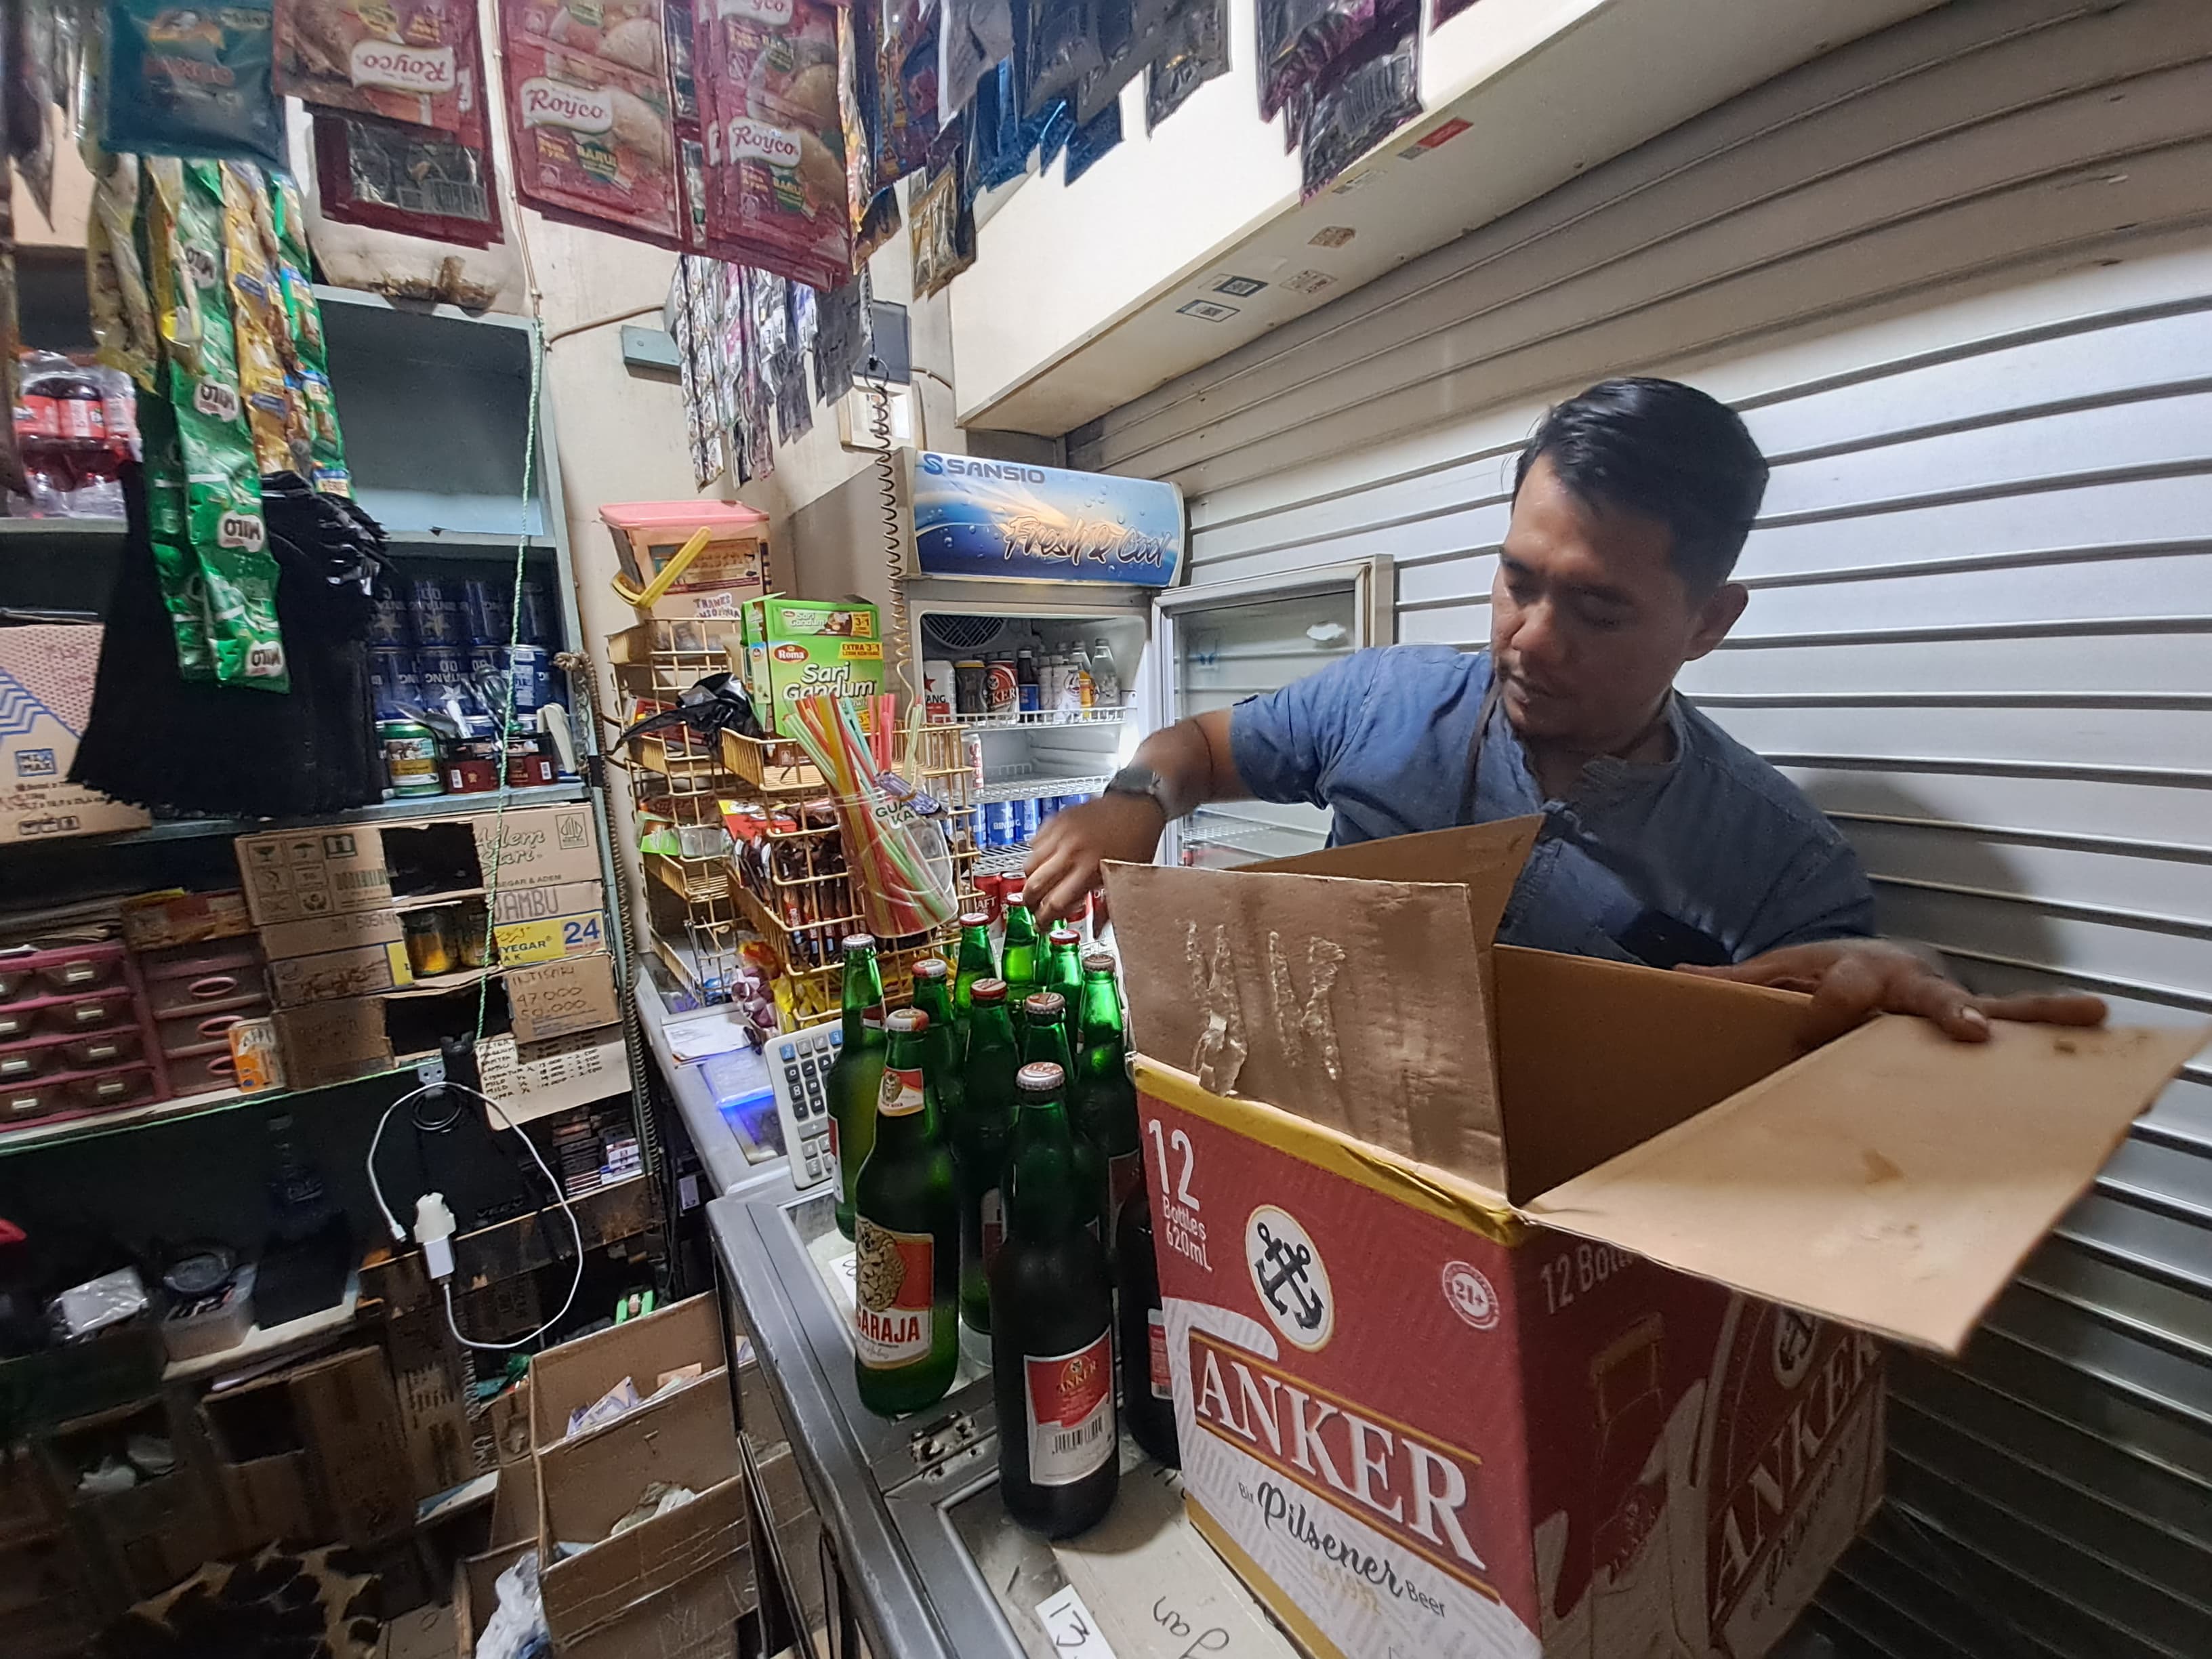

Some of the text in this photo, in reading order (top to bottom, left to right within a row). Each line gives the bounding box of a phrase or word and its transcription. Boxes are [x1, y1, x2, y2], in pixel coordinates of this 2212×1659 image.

[364, 54, 448, 82] Royco
[526, 89, 604, 119] Royco
[732, 125, 794, 155] Royco
[946, 459, 1045, 484] SANSIO
[224, 518, 262, 541] MILO
[1004, 515, 1083, 567] Fresh
[1116, 526, 1172, 568] Cool
[251, 648, 281, 668] MILO
[778, 650, 805, 659] Roma
[801, 661, 851, 684] Sari
[783, 675, 874, 701] Gandum
[563, 918, 600, 945] 24
[1149, 1119, 1200, 1212] 12
[1162, 1194, 1207, 1242] Bottles
[1540, 1254, 1574, 1315] 12
[1197, 1349, 1486, 1570] ANKER
[1257, 1481, 1404, 1597] Pilsener
[1405, 1579, 1446, 1618] Beer
